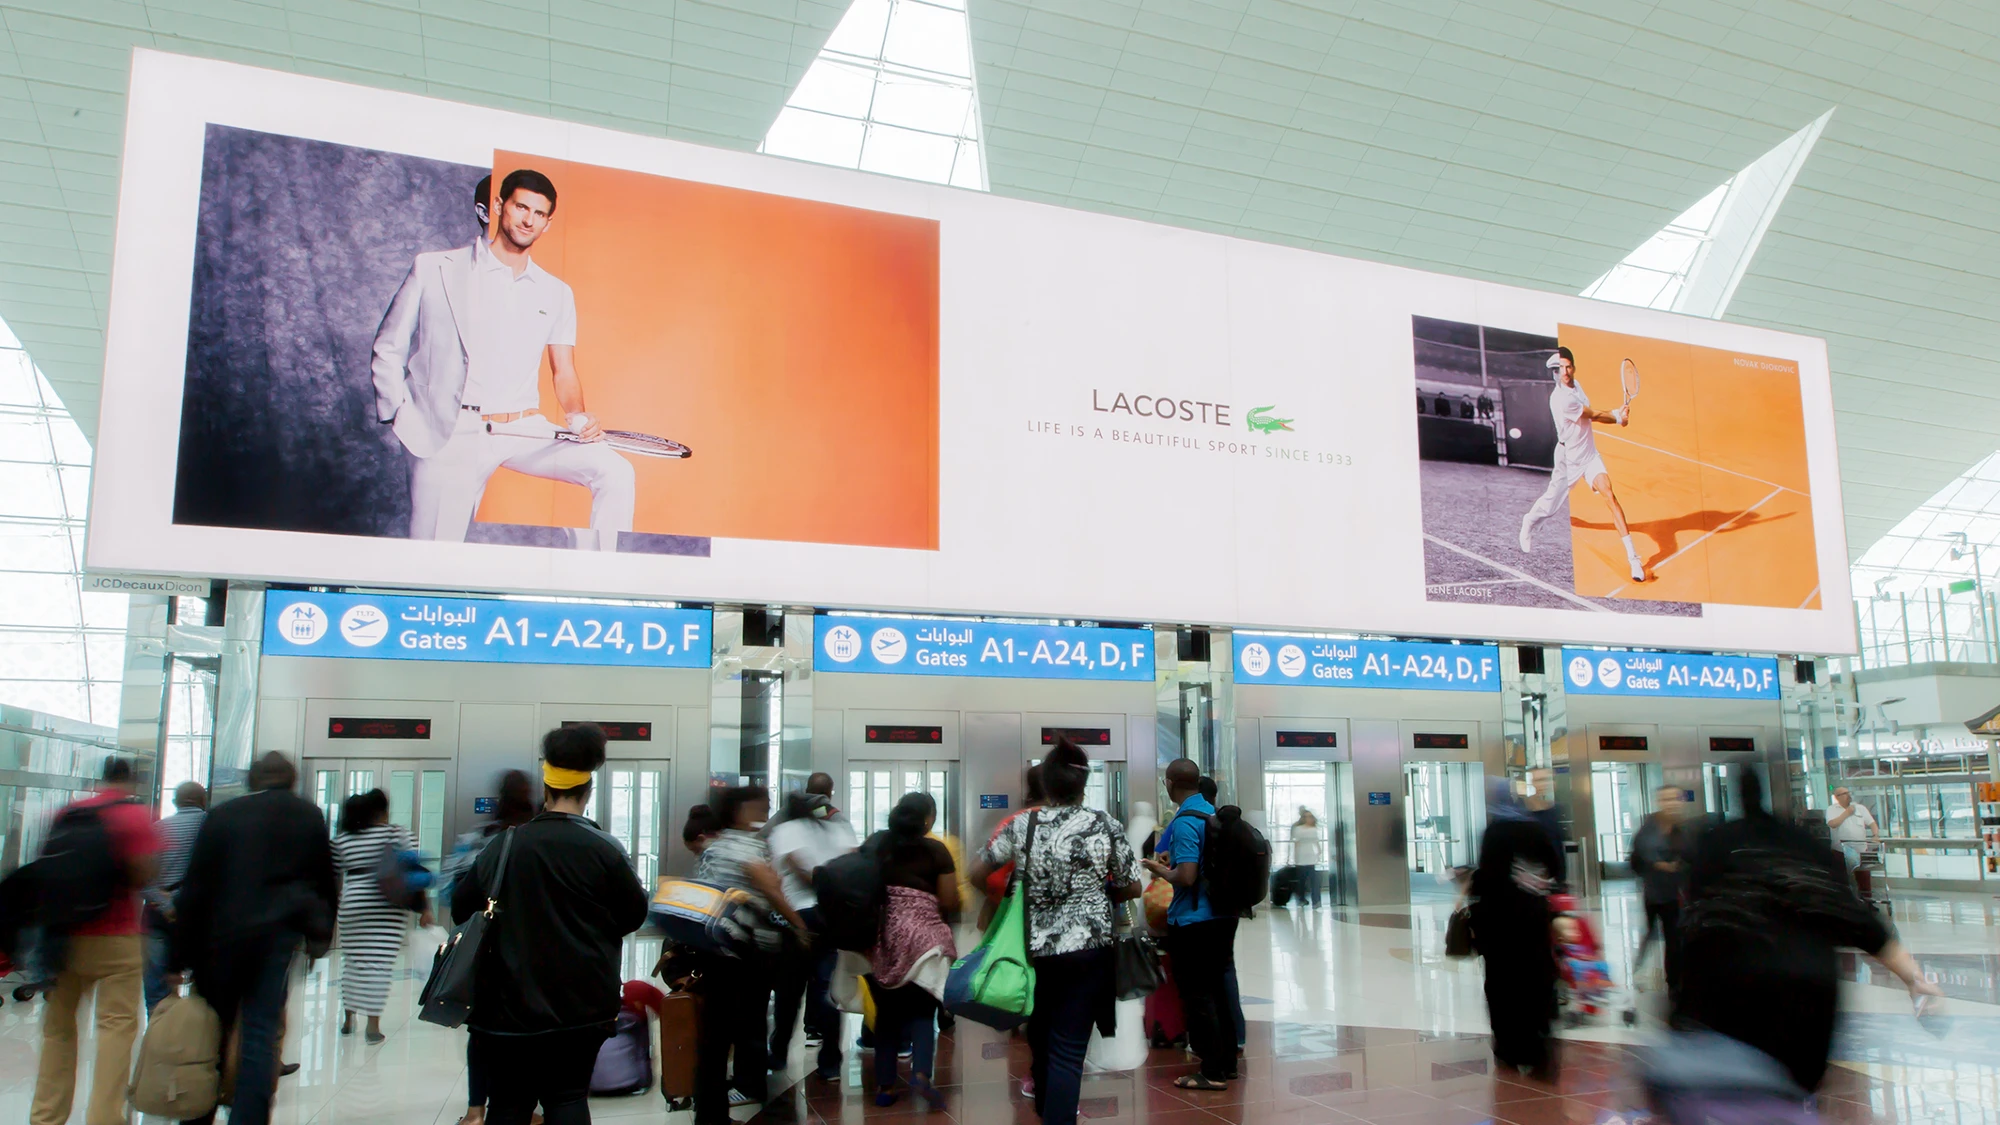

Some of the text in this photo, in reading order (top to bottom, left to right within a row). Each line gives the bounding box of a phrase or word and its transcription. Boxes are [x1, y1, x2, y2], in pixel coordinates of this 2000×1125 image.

[1733, 357, 1795, 374] NOVAK DJOKOVIC
[1092, 389, 1231, 427] LACOSTE
[1028, 420, 1352, 466] LIFE IS A BEAUTIFUL SPORT SINCE 1933
[92, 578, 202, 592] JCDecauxDicon
[1453, 586, 1492, 598] LACOSTE
[401, 604, 477, 627] البوابات
[400, 630, 467, 650] Gates
[915, 627, 973, 647] البوابات
[916, 649, 967, 667] Gates
[1311, 644, 1357, 661] البوابات
[1312, 663, 1354, 679] Gates
[1625, 657, 1662, 673] البوابات
[1626, 674, 1660, 690] Gates
[1889, 738, 1945, 754] COSTA
